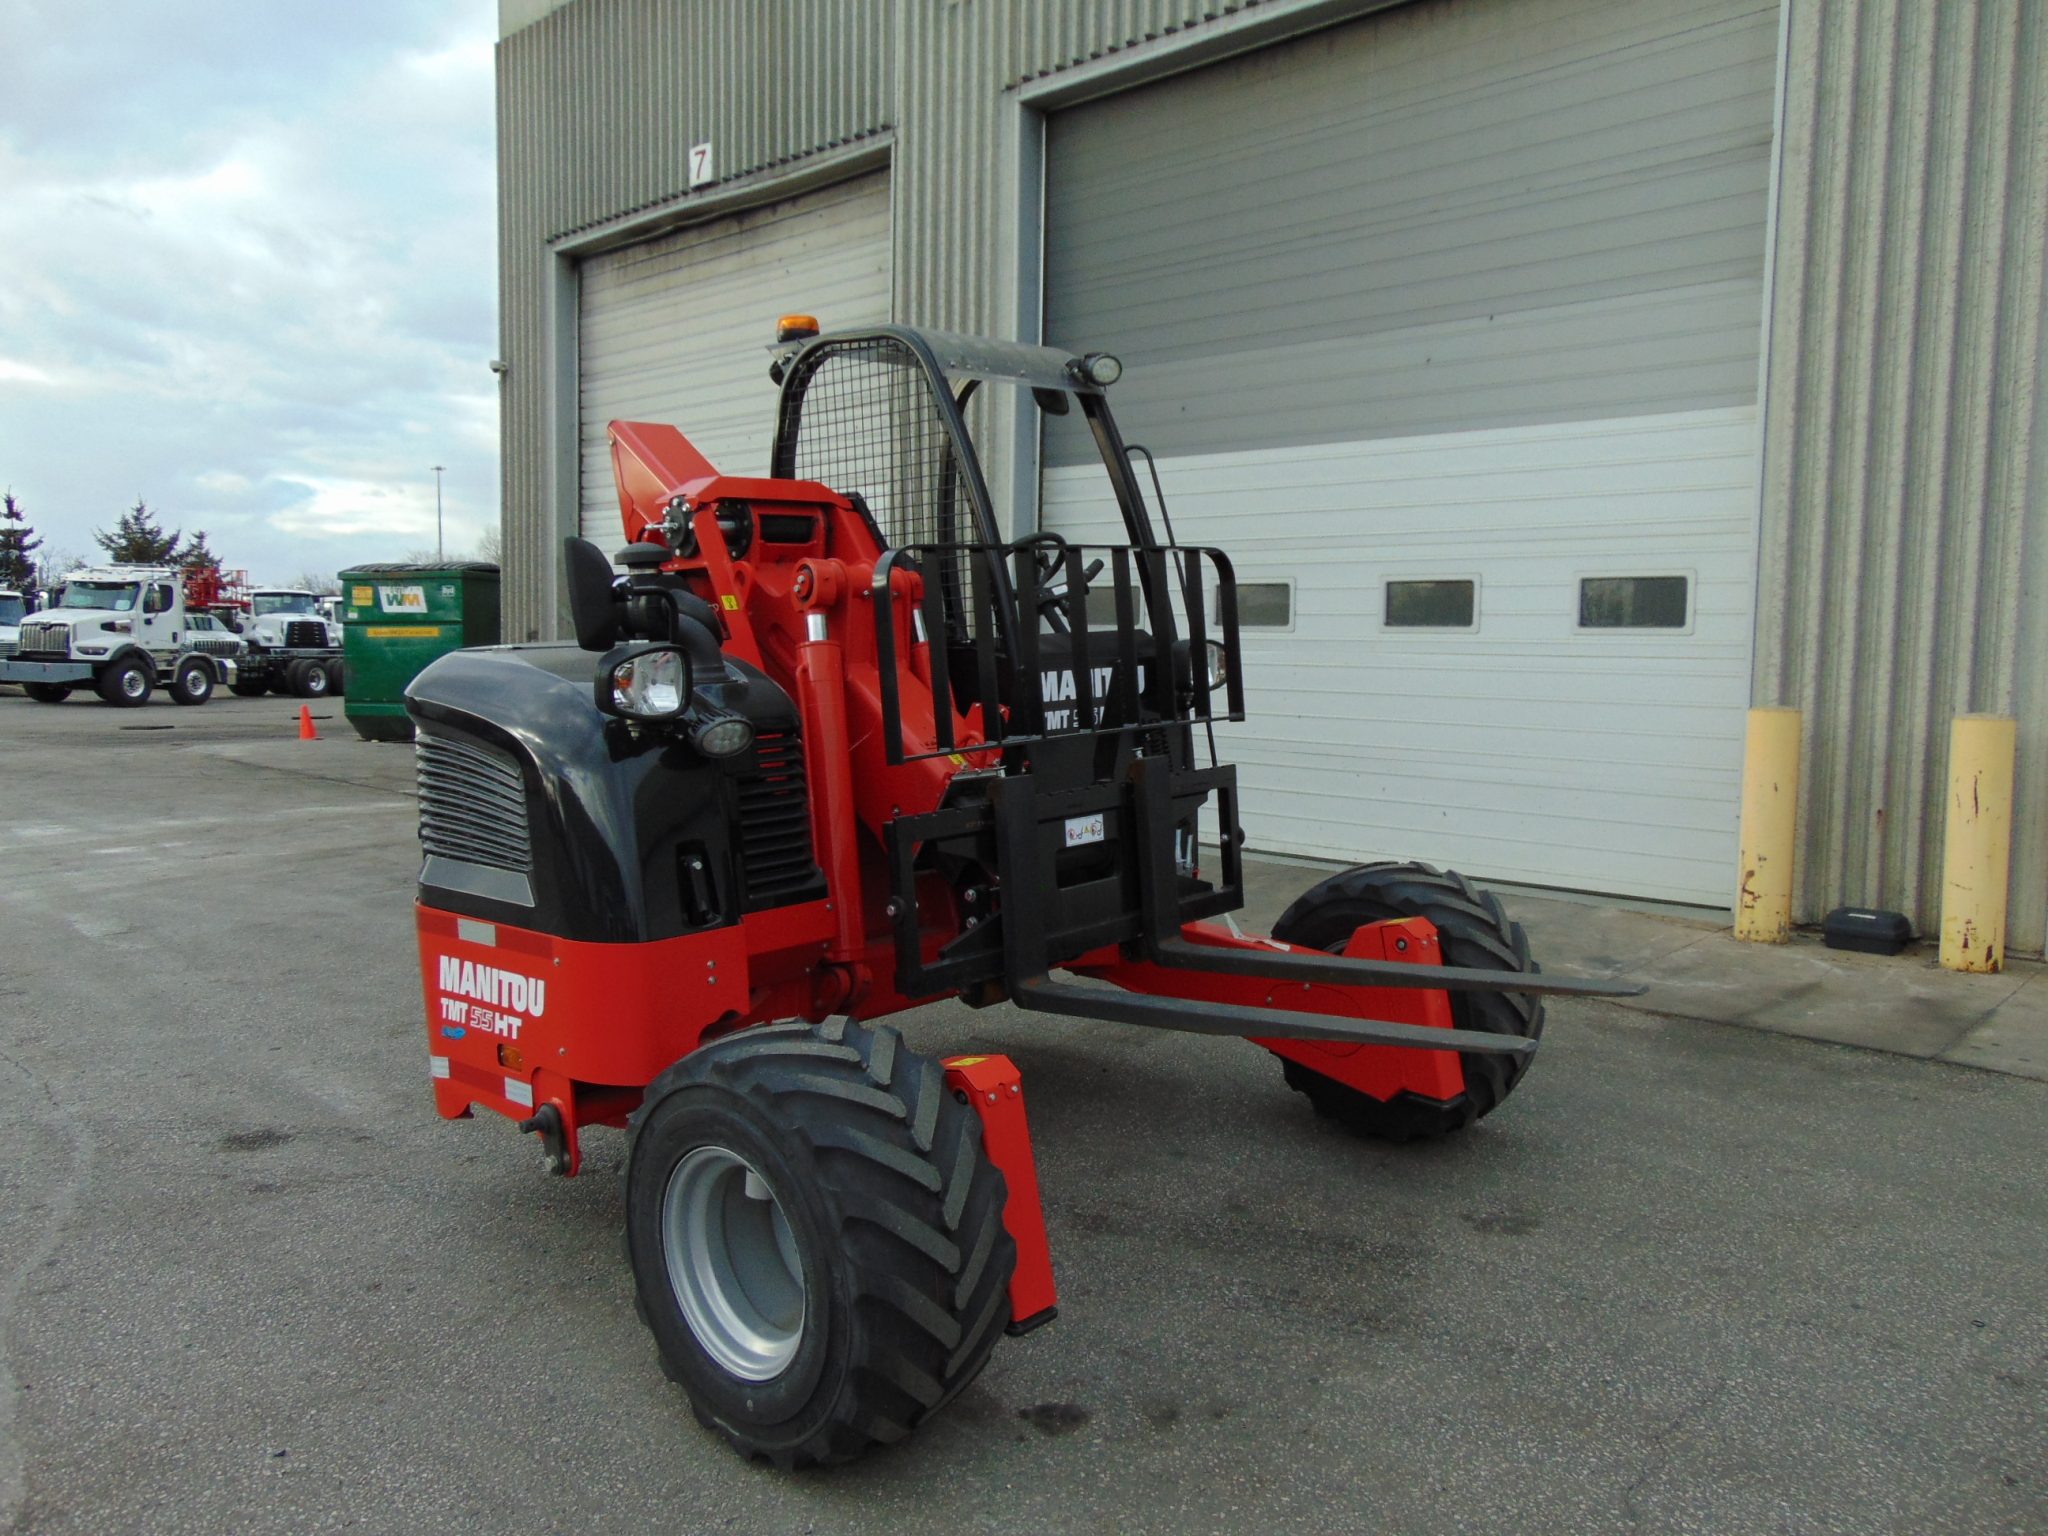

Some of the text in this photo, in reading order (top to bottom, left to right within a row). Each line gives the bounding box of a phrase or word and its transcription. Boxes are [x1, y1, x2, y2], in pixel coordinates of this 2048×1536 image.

[695, 149, 706, 180] 7
[385, 593, 420, 606] WM
[440, 955, 545, 1017] MANITOU
[441, 997, 468, 1024] TMT
